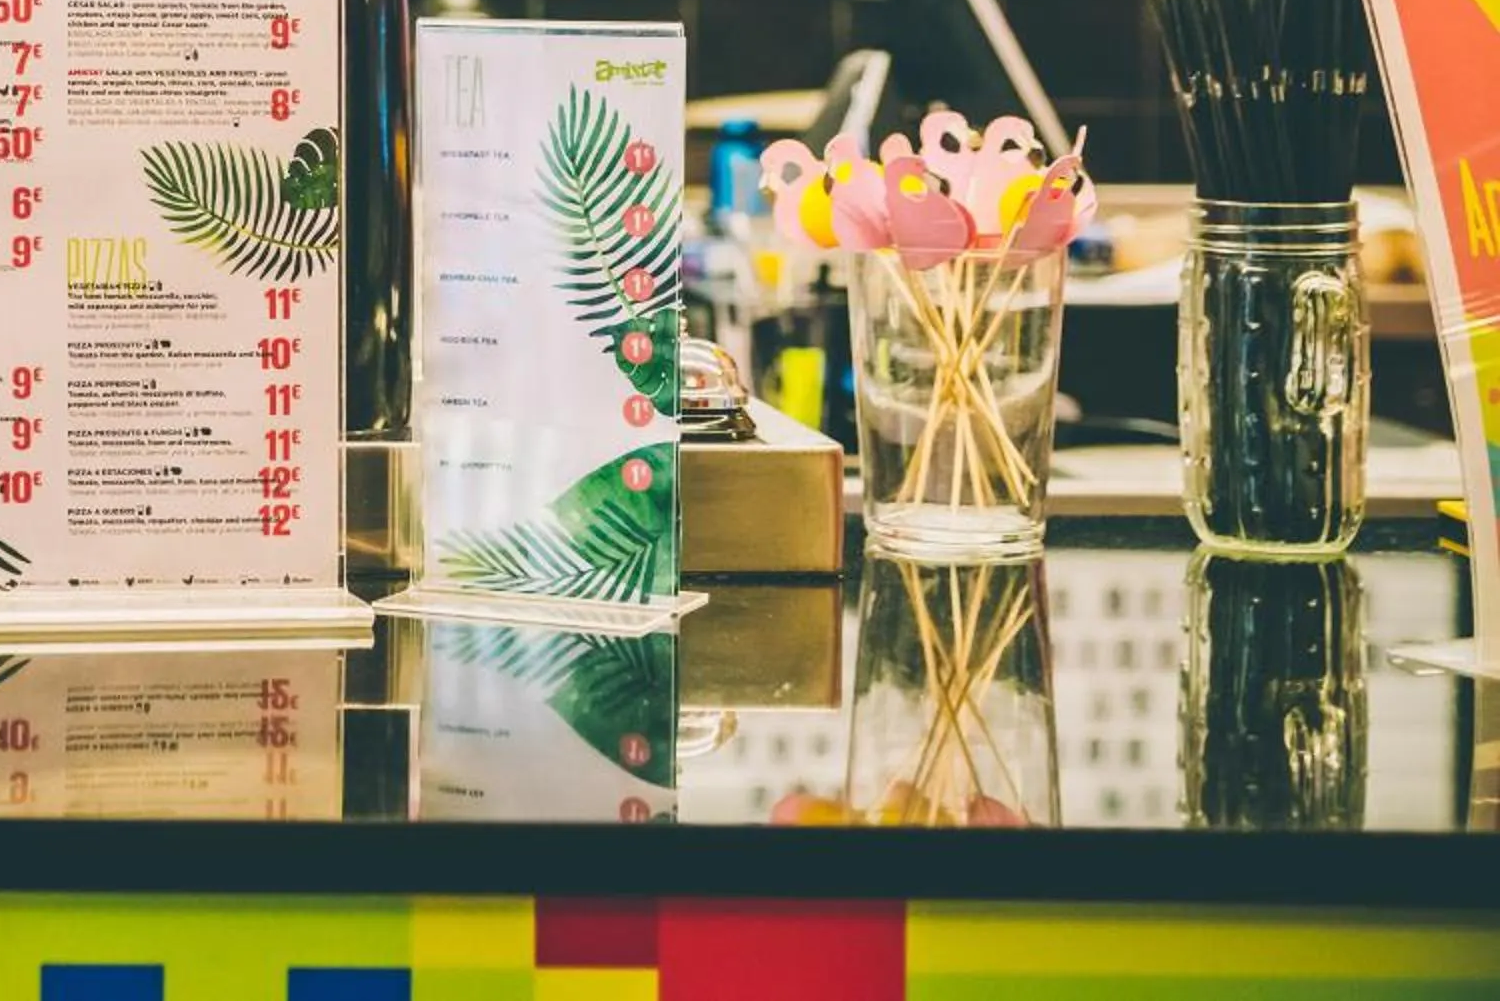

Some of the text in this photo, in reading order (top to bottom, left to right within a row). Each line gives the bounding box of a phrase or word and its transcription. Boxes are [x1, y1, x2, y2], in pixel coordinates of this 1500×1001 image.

[271, 18, 300, 49] 9€
[13, 43, 42, 75] 7€
[16, 85, 42, 117] 7€
[271, 89, 300, 121] 8€
[13, 187, 43, 219] 6€
[13, 236, 43, 268] 9€
[265, 288, 300, 319] 11€
[258, 338, 300, 370] 10€
[13, 366, 43, 399] 9€
[265, 384, 301, 416] 11€
[13, 418, 43, 450] 9€
[265, 429, 301, 461] 11€
[258, 466, 301, 498] 12€
[258, 504, 301, 535] 12€
